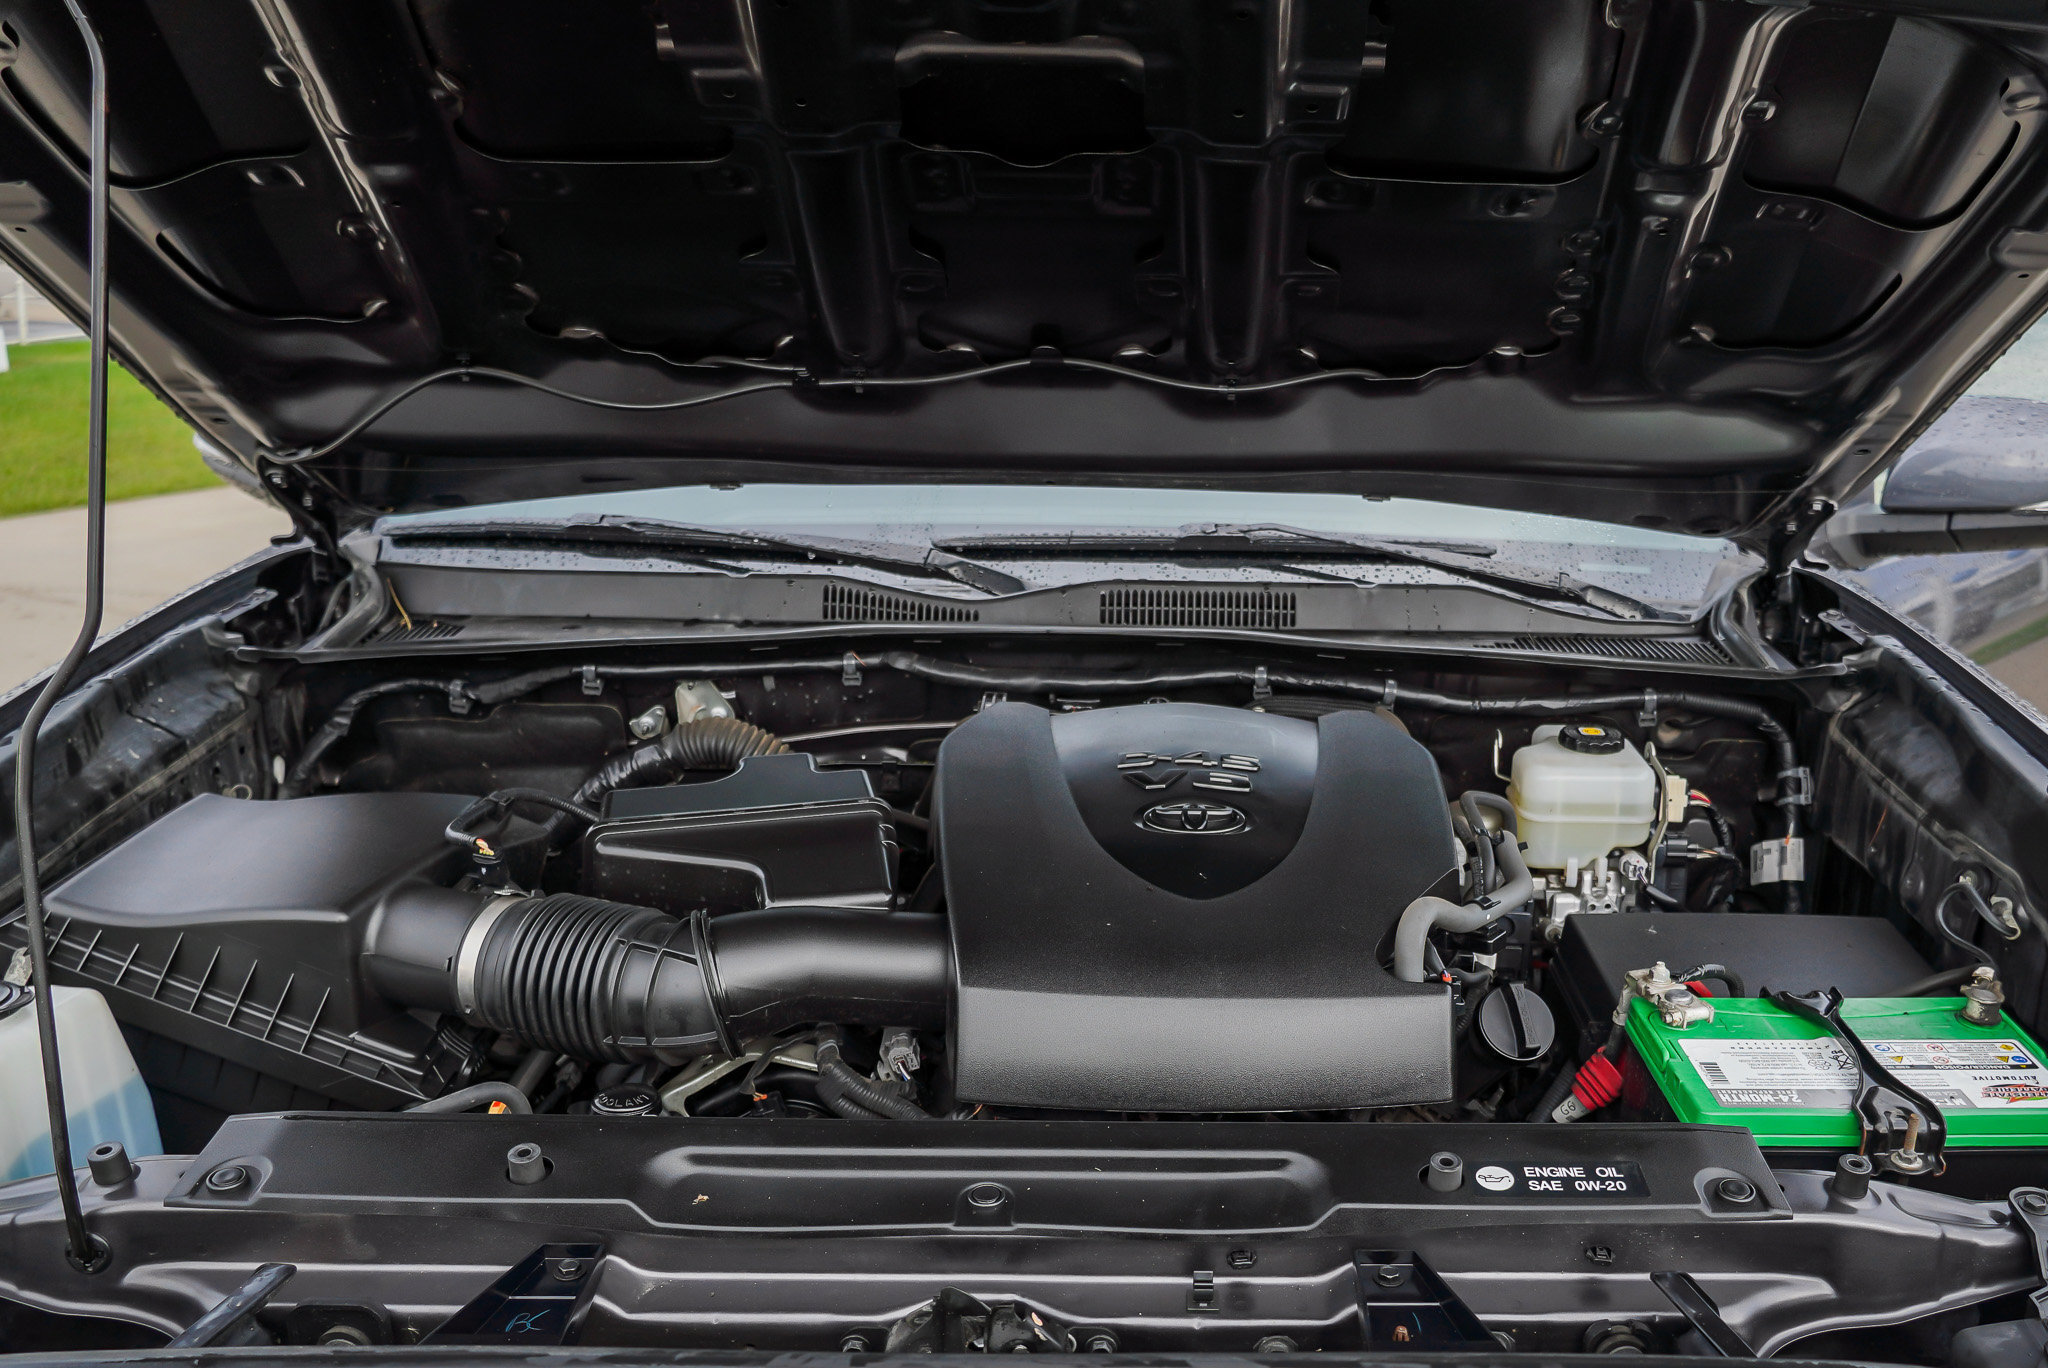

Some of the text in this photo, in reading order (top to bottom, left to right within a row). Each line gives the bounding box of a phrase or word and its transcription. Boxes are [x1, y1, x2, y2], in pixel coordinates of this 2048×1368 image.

[1116, 751, 1261, 772] D-4S
[1121, 768, 1254, 793] V6
[1972, 1075, 2039, 1083] AUTOMOTIVE
[598, 1093, 650, 1108] COOLANT
[1718, 1093, 1803, 1103] 24-MONTH
[1523, 1166, 1625, 1178] ENGINE OIL
[1528, 1180, 1628, 1191] SAE 0W-20
